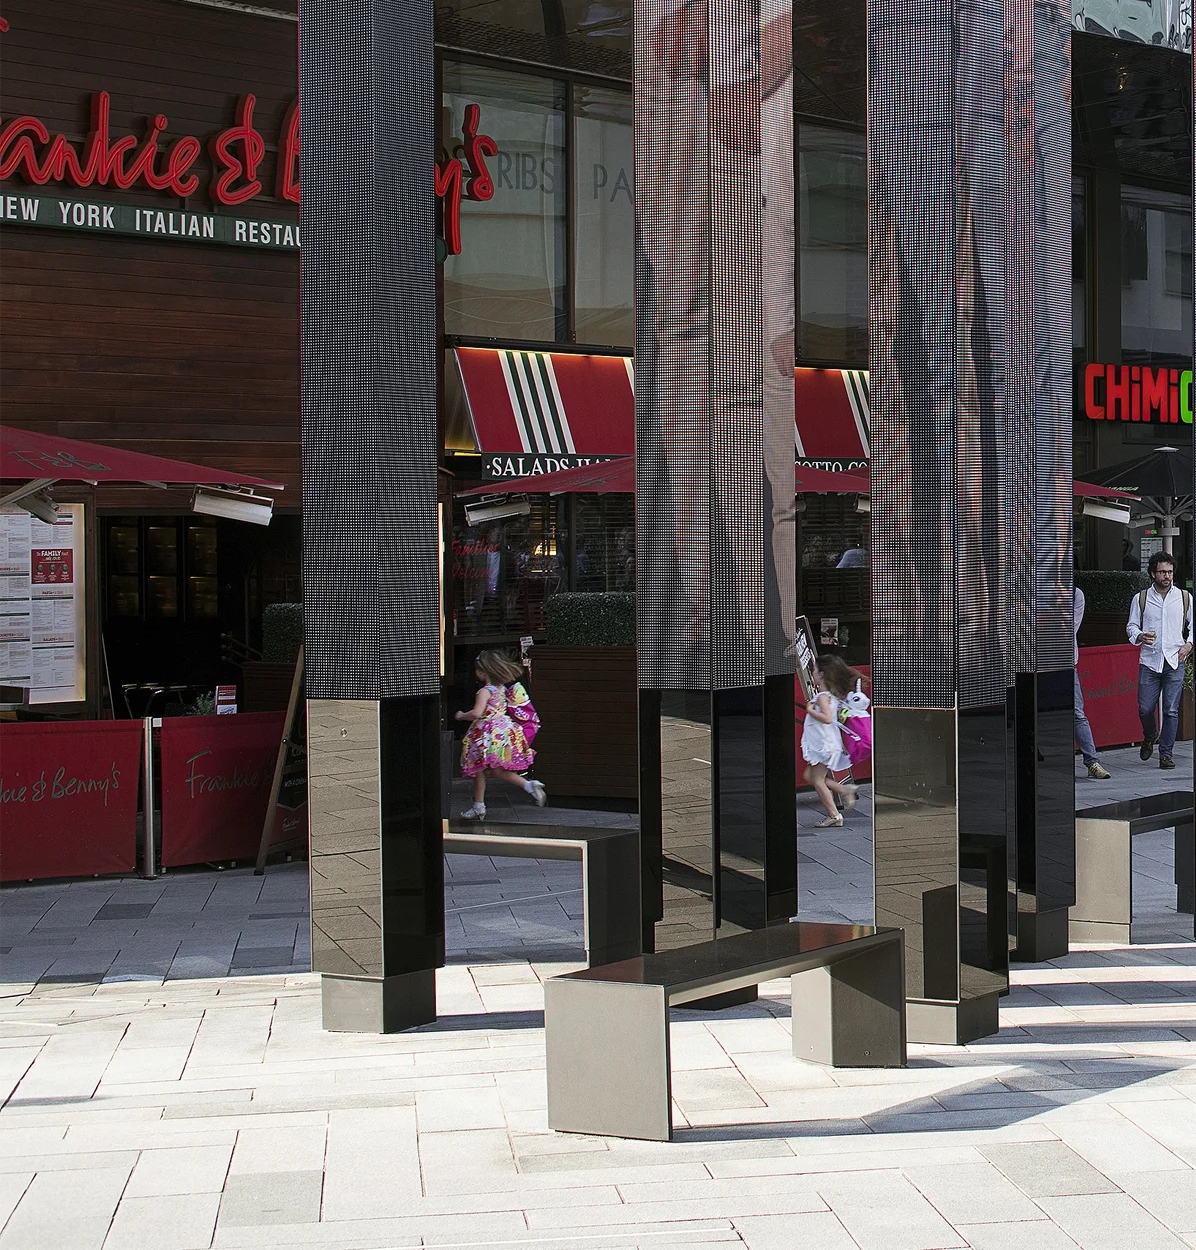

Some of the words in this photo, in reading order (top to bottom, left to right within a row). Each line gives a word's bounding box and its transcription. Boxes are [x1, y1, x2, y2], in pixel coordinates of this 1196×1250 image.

[497, 151, 556, 195] RIBS
[59, 201, 115, 229] YORK
[135, 209, 215, 238] ITALIAN
[51, 762, 121, 807] Benny's
